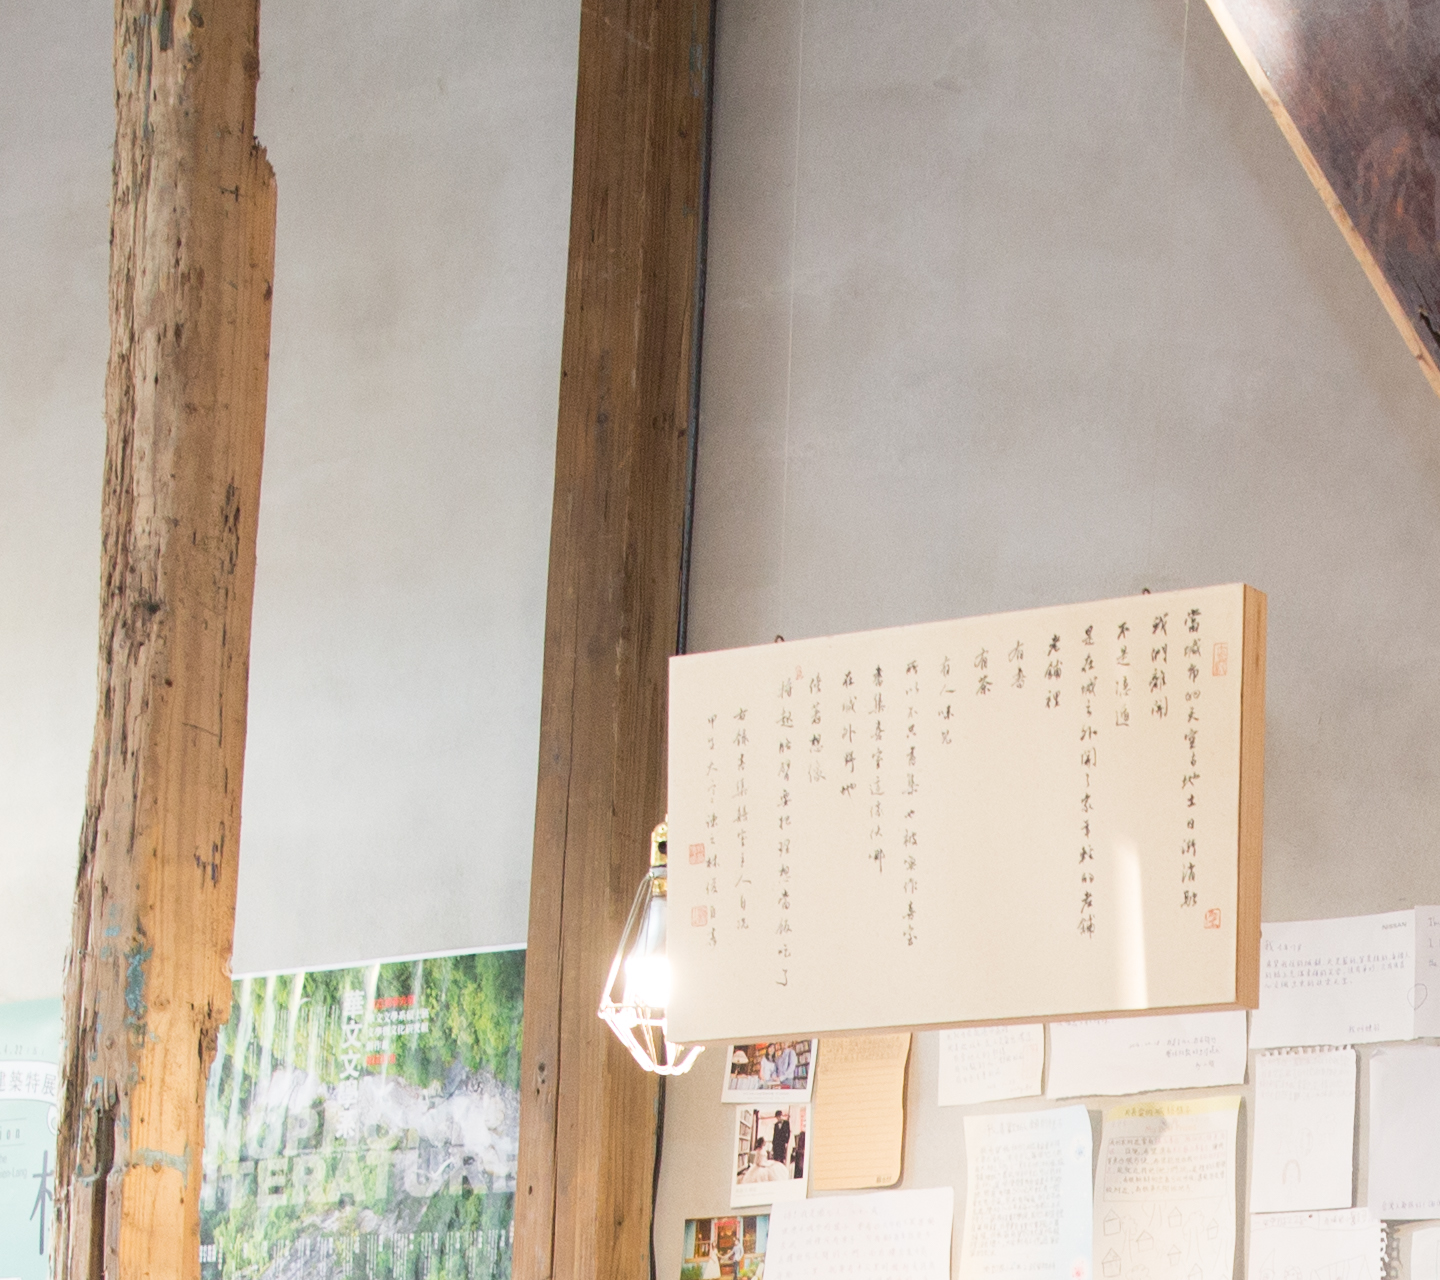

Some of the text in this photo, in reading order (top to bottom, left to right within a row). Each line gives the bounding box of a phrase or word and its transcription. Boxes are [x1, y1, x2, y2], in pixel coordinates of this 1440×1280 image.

[972, 647, 995, 697] 有茶
[1148, 613, 1170, 721] 我們離開
[335, 989, 366, 1140] 華文文學系
